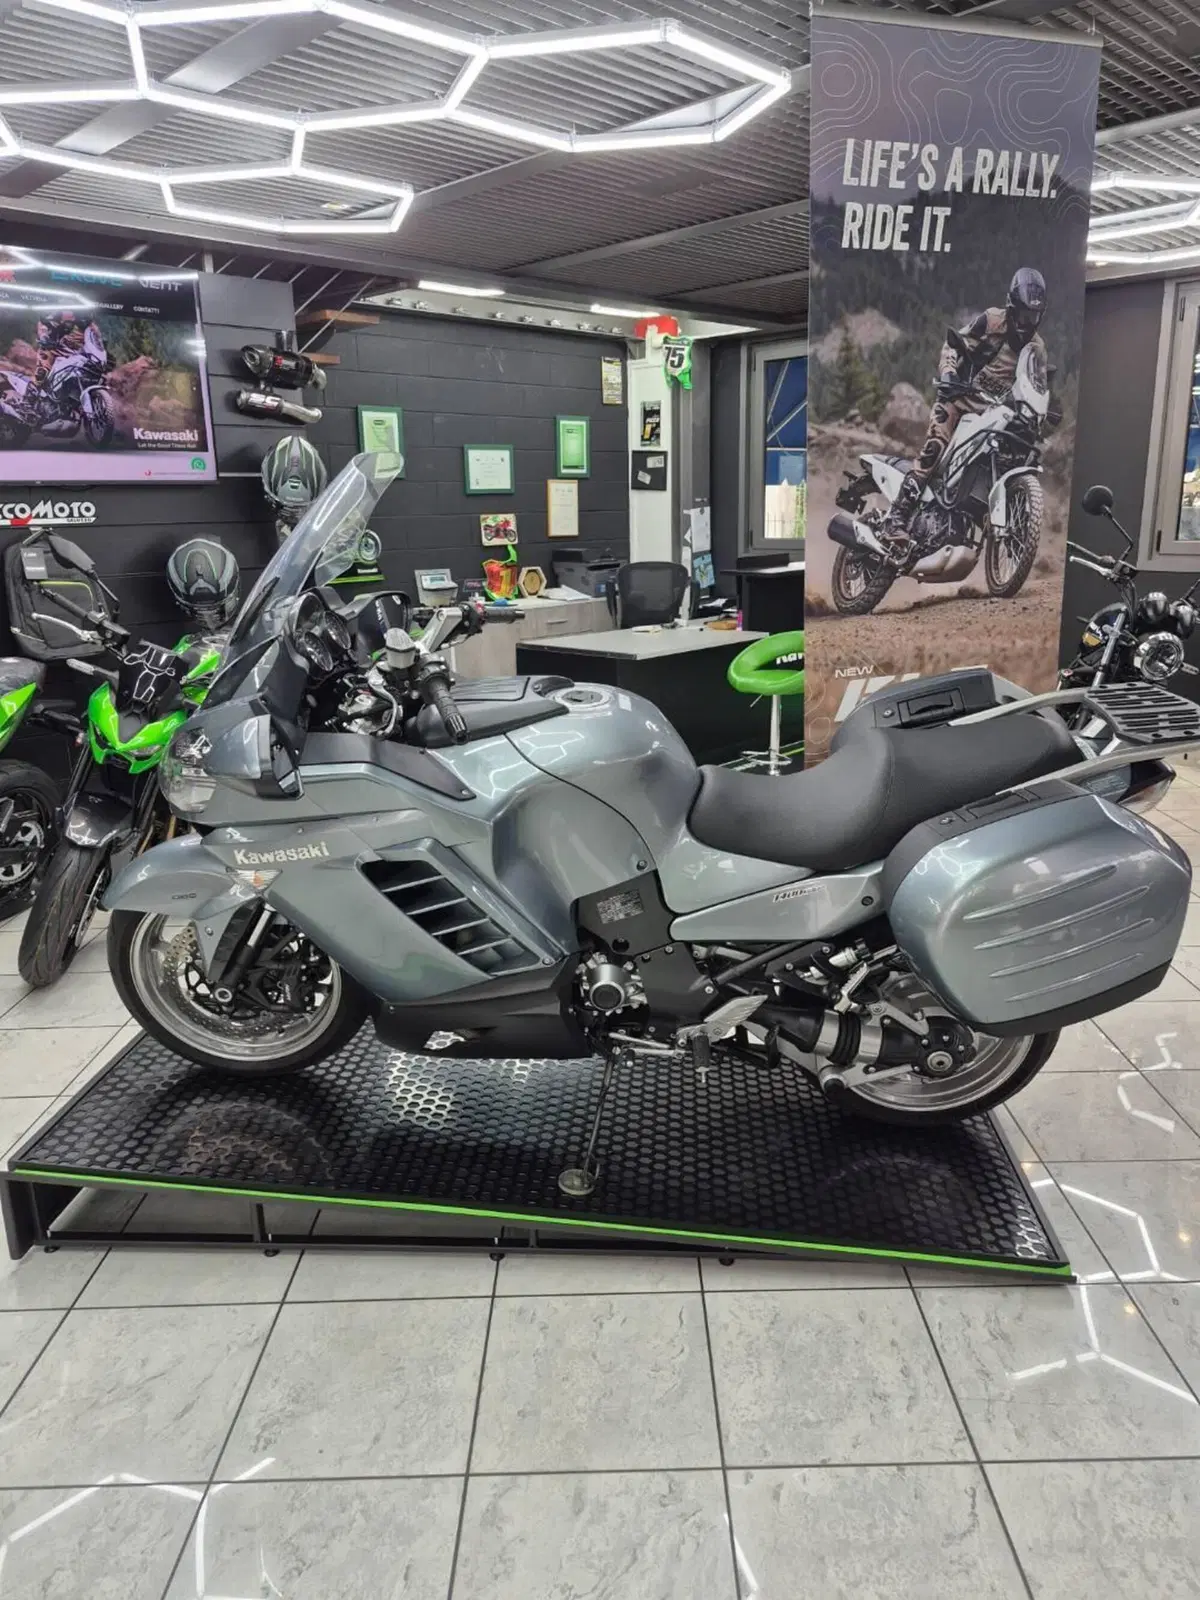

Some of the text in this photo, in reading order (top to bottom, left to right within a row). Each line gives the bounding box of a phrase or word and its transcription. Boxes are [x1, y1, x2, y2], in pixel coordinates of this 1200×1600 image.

[842, 138, 1060, 199] LIFE'S A RALLY.
[841, 201, 952, 253] RIDE IT.
[664, 346, 685, 369] 75
[133, 427, 199, 441] Kawasaki
[835, 665, 874, 678] NEW
[234, 841, 330, 864] Kawasaki
